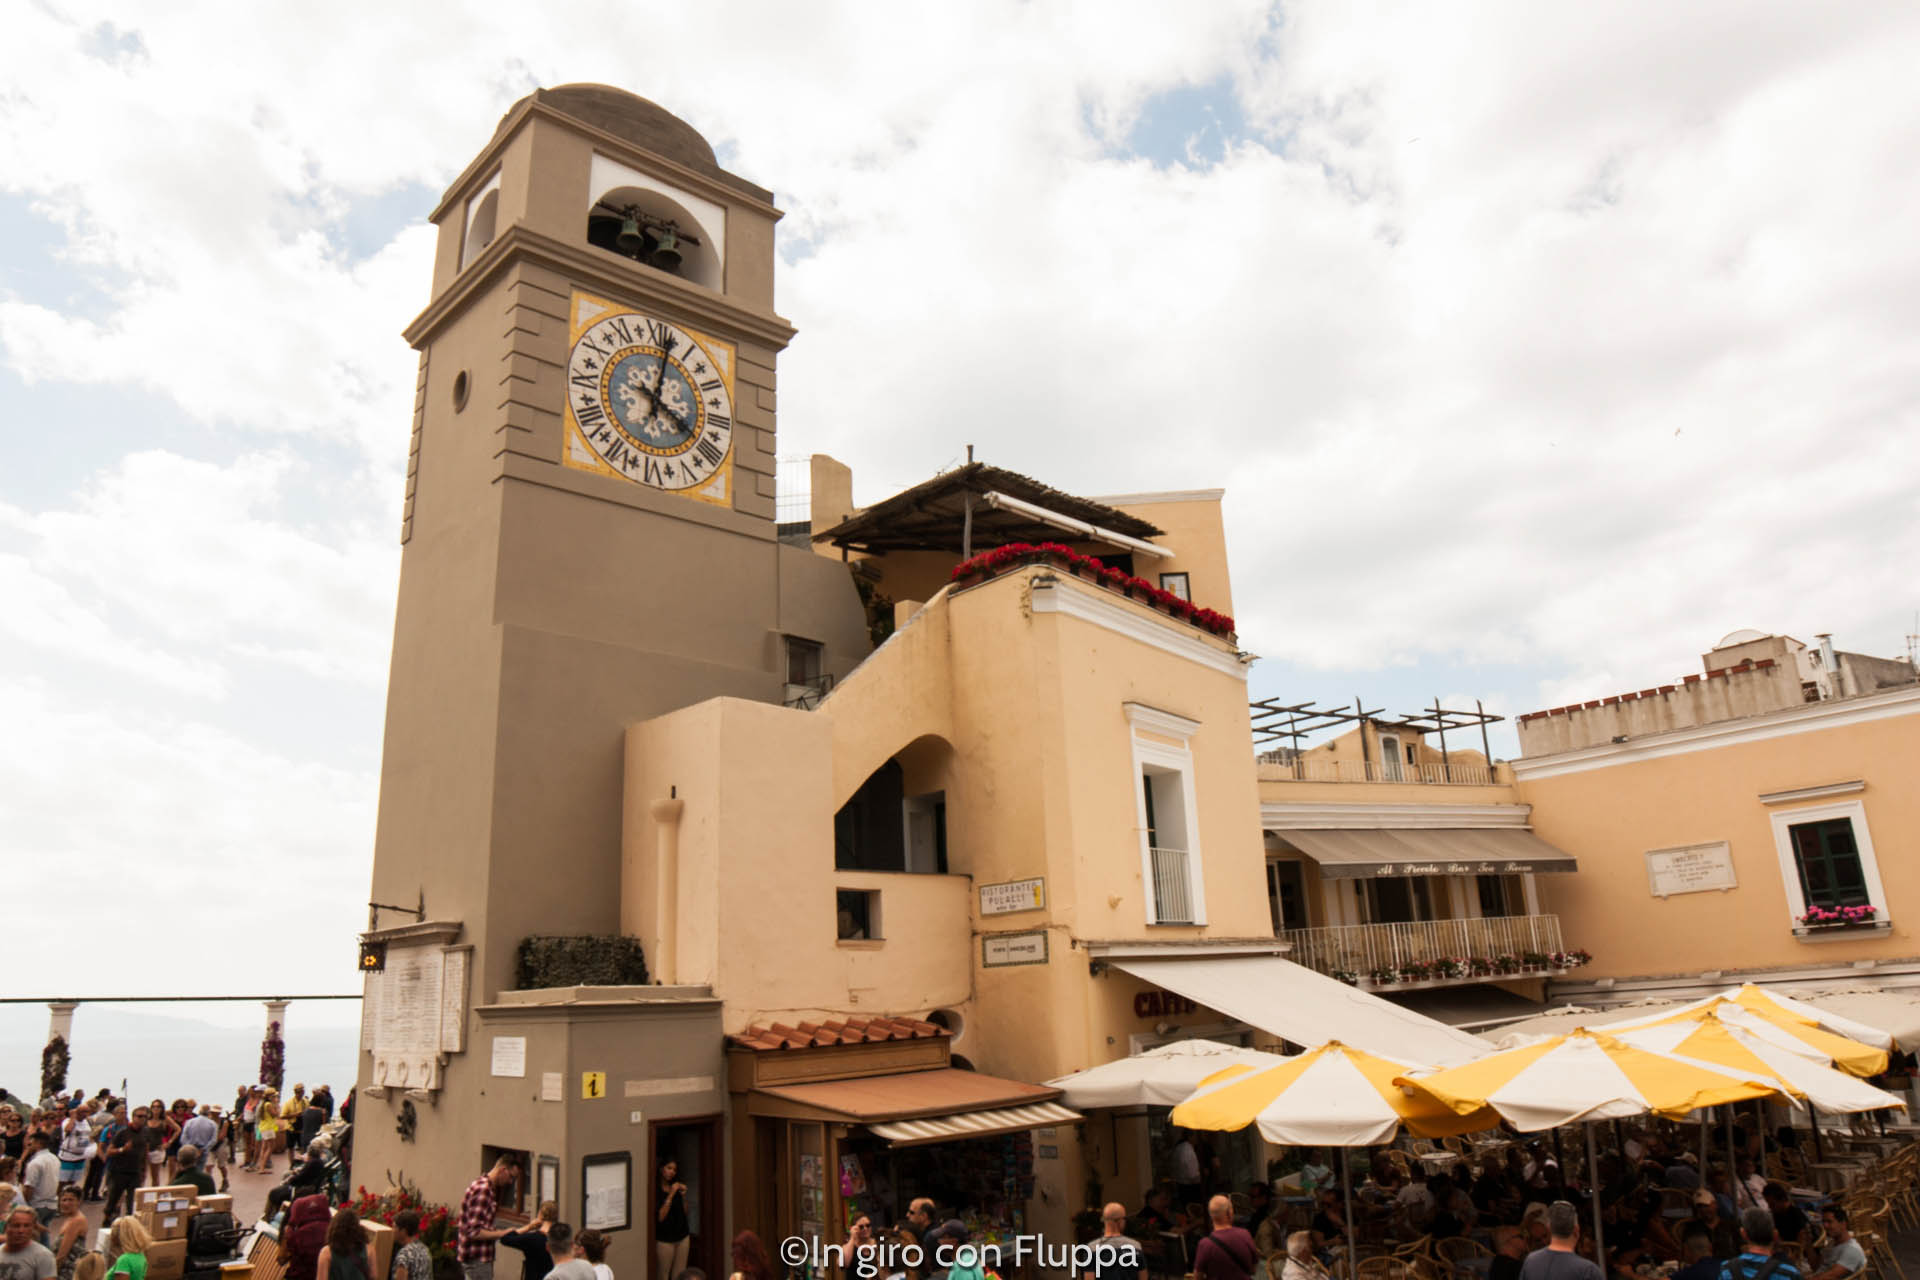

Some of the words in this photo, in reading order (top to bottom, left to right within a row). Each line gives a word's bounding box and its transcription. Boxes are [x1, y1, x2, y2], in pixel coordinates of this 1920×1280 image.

[609, 317, 633, 345] XI
[582, 335, 610, 362] X
[681, 344, 697, 362] I
[700, 378, 723, 392] II
[706, 412, 731, 432] III
[680, 459, 699, 486] V
[1448, 862, 1470, 873] Bar
